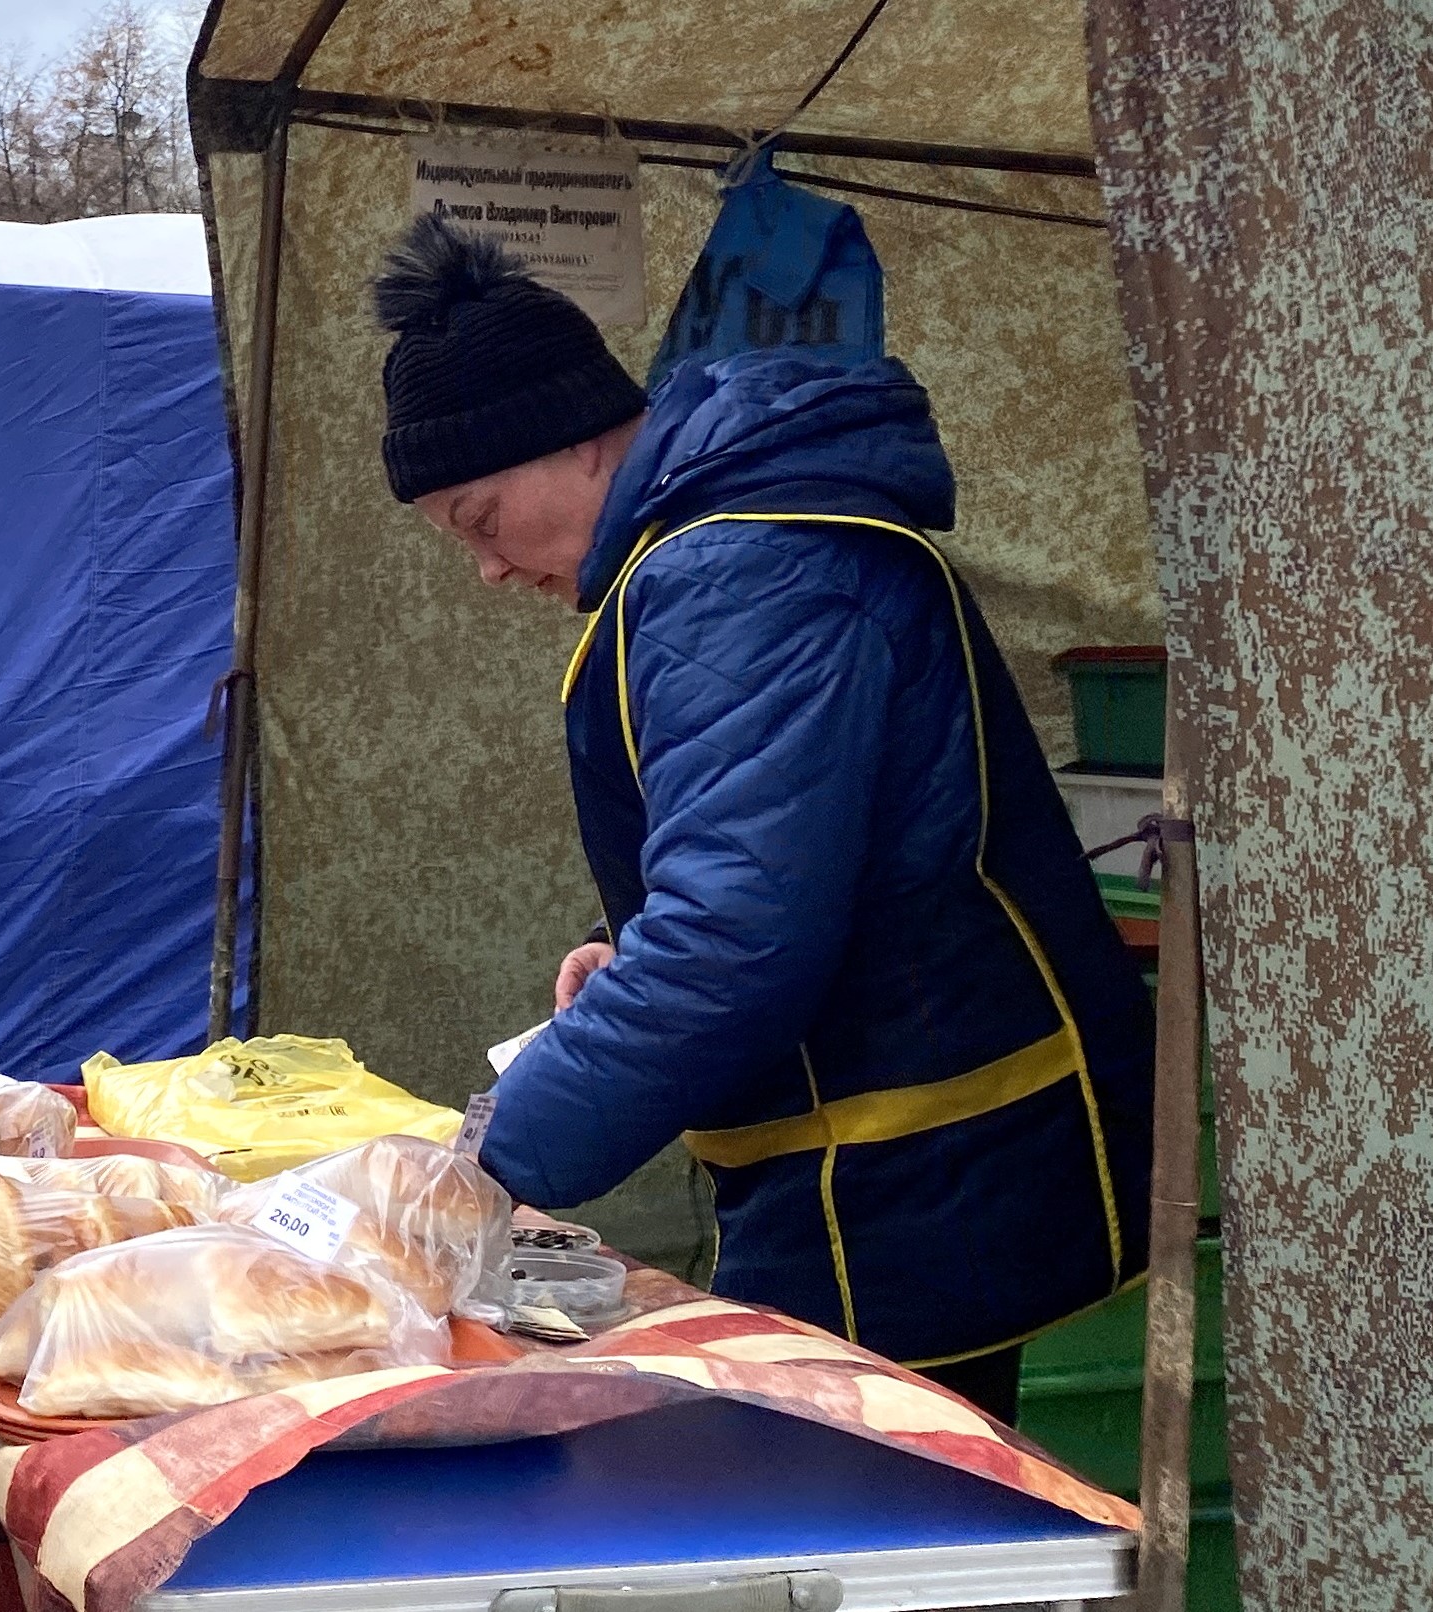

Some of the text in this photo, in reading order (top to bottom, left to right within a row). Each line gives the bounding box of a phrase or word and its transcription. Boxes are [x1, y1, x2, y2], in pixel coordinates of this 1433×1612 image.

[417, 160, 633, 193] Индивидуальный предприниматель
[485, 201, 549, 229] Владимир
[550, 204, 623, 231] Викторович
[269, 1208, 310, 1237] 26,00
